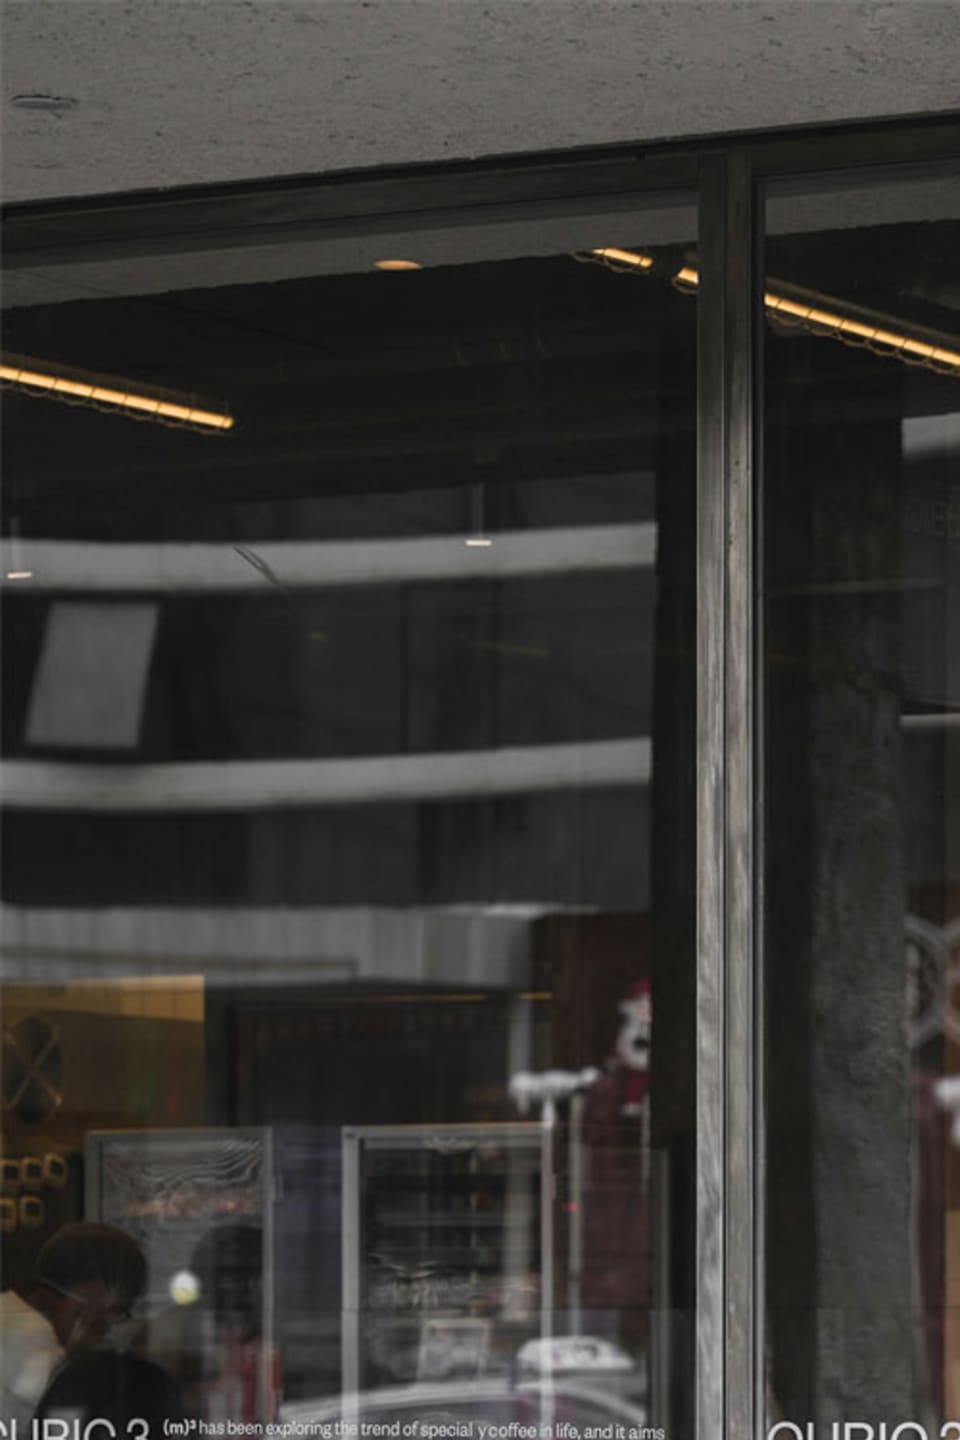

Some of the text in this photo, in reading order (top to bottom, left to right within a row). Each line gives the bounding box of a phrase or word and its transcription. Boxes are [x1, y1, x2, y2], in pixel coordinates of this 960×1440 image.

[199, 1421, 226, 1435] has
[227, 1421, 264, 1436] been
[265, 1421, 333, 1440] exploring
[335, 1421, 358, 1436] the
[361, 1421, 400, 1437] trend
[402, 1421, 420, 1437] of
[540, 1422, 553, 1438] in
[556, 1422, 582, 1440] life,
[584, 1423, 613, 1439] and
[615, 1423, 626, 1439] it
[628, 1423, 665, 1440] aims
